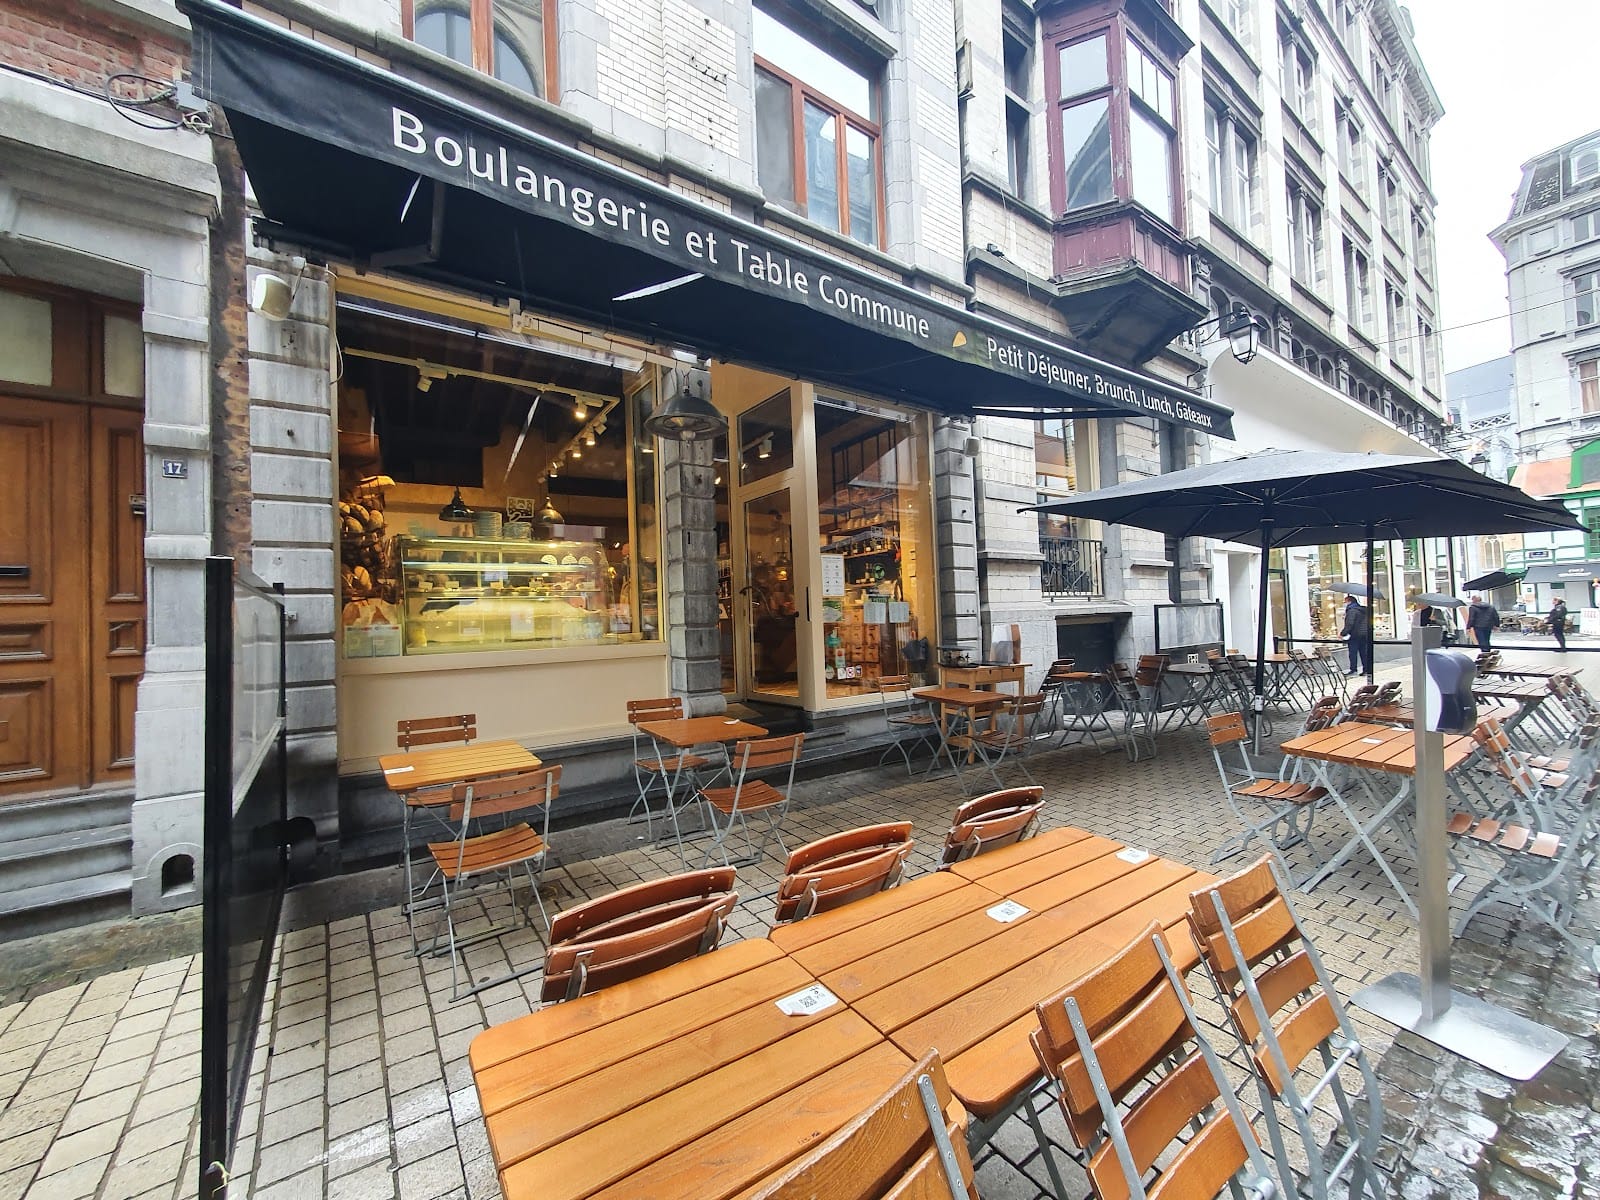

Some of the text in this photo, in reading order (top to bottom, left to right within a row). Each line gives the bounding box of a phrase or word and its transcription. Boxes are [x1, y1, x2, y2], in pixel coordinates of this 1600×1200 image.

[391, 106, 930, 338] Boulangerie et Table Commune
[987, 337, 1213, 429] Petit Déjeuner, Brunch, Lunch, Gâteaux
[167, 462, 182, 474] 17
